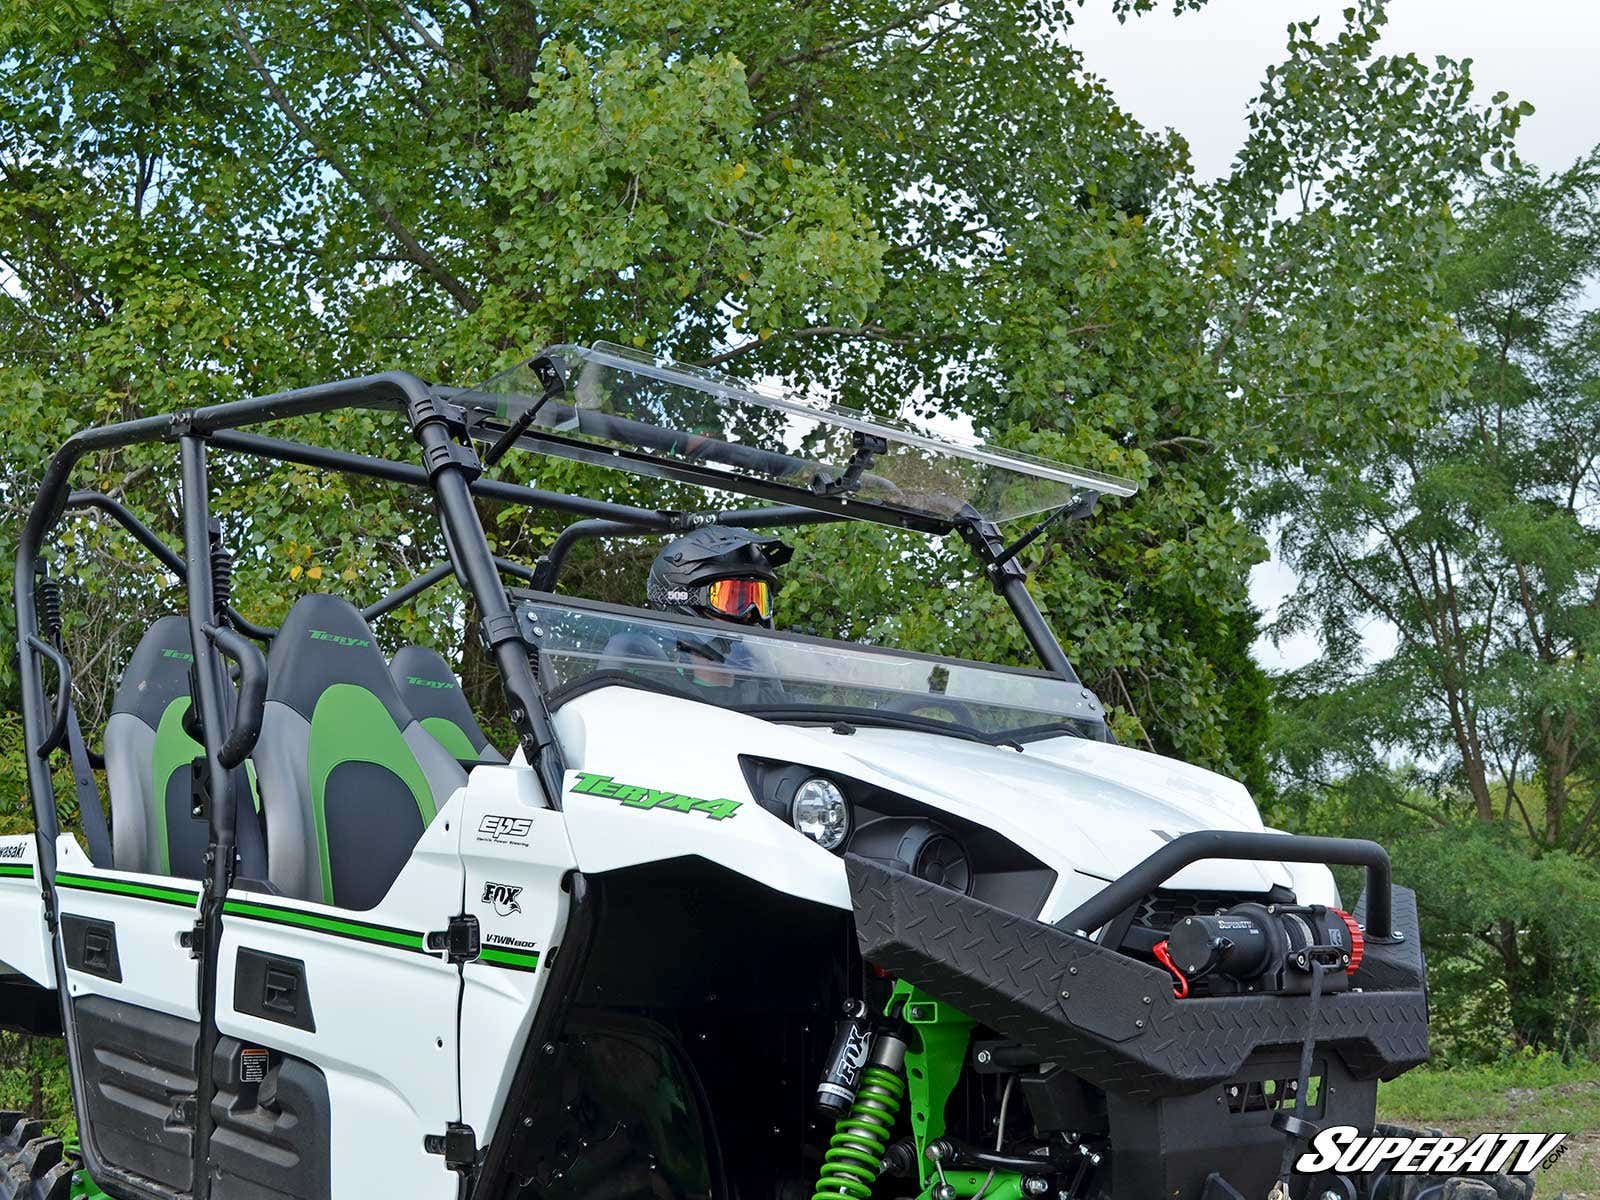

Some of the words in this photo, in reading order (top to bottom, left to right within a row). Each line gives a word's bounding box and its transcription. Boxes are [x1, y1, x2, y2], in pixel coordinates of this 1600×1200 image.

[667, 591, 688, 601] 509
[478, 814, 534, 839] EPS
[0, 842, 27, 858] asaki
[481, 881, 523, 906] FOX
[837, 1024, 866, 1086] FOX
